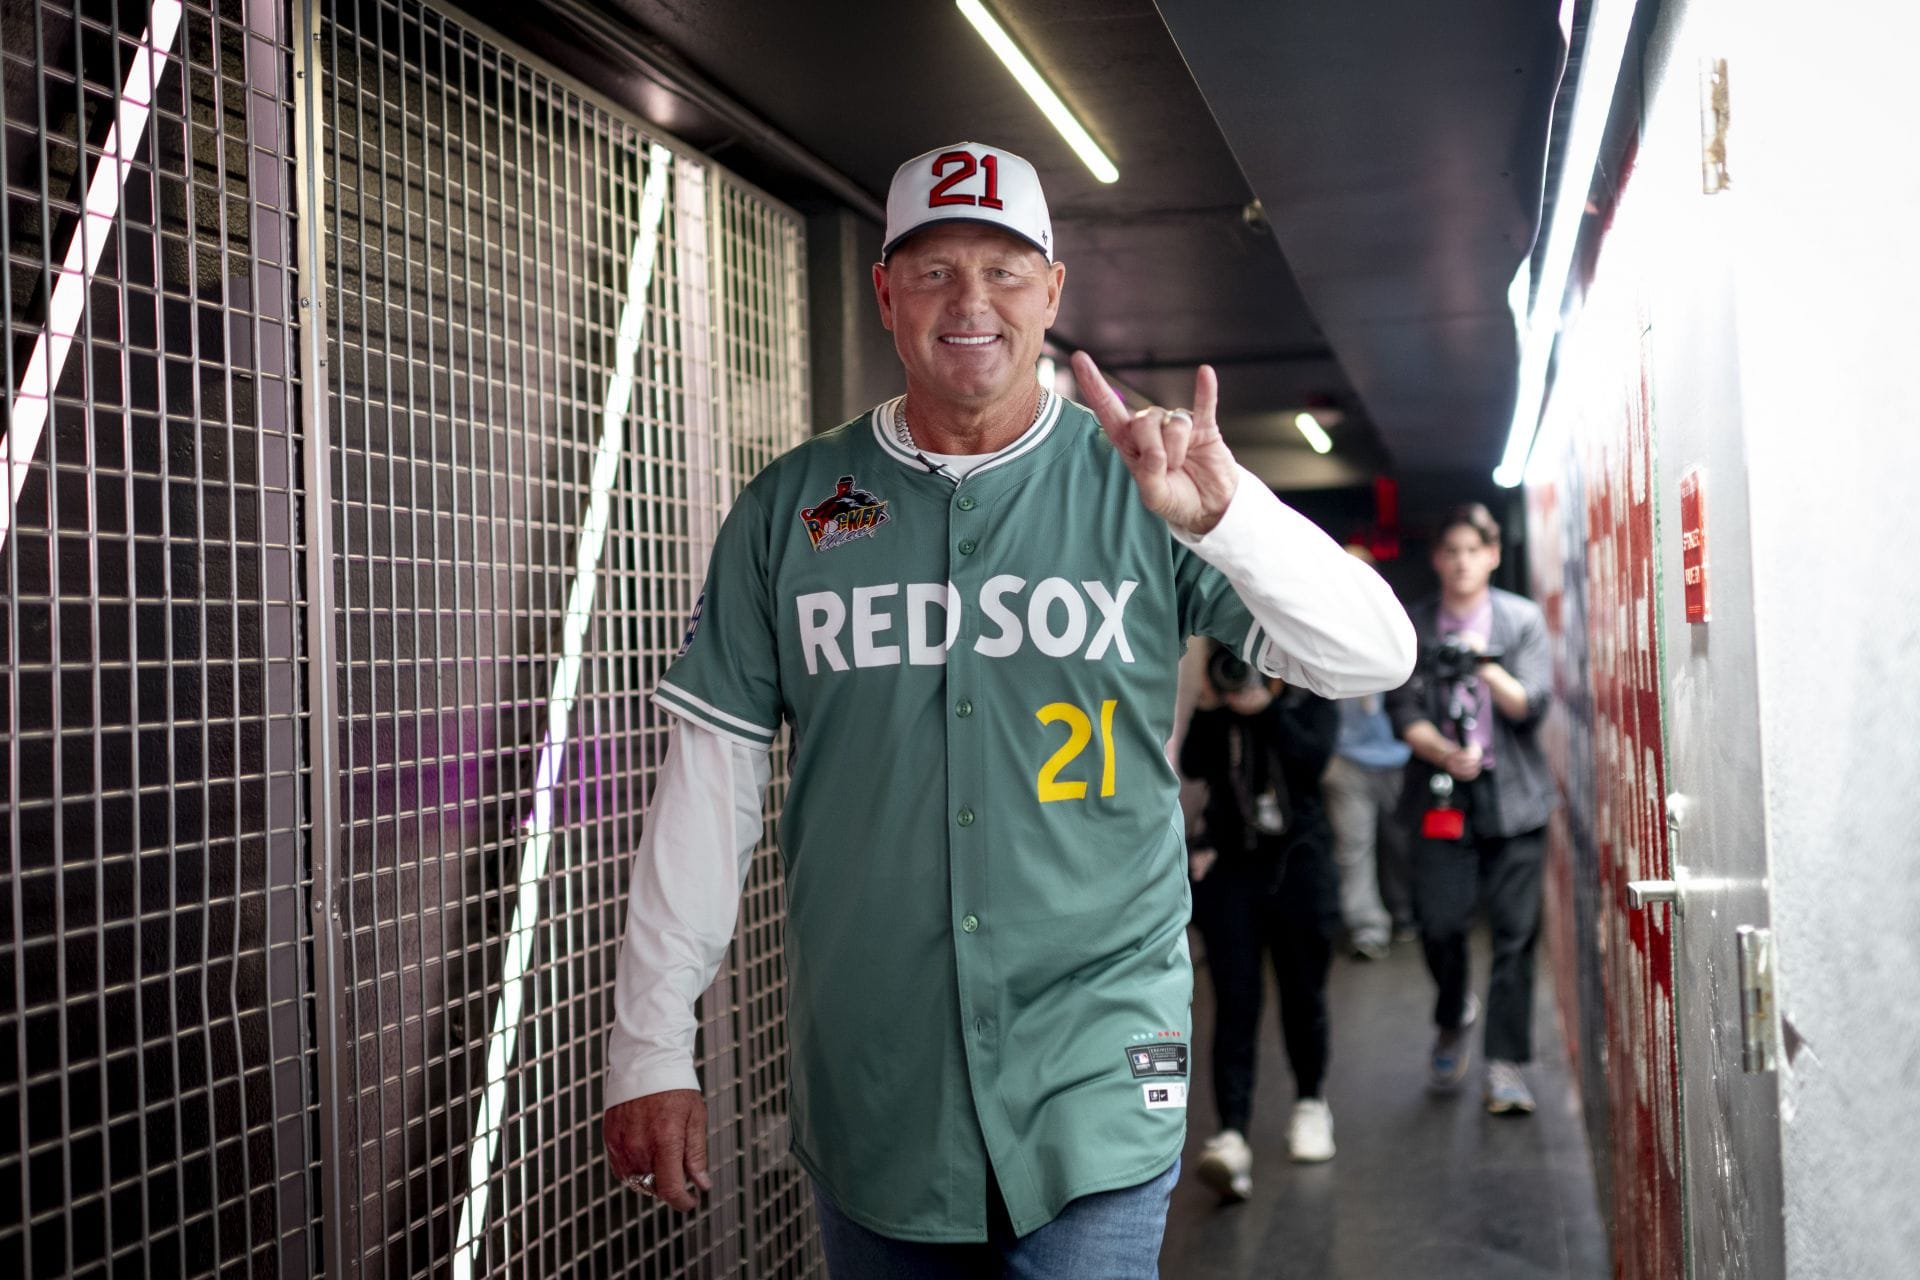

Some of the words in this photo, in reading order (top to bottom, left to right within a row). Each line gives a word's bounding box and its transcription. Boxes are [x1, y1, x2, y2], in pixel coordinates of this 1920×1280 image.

[929, 151, 1003, 210] 21
[796, 580, 962, 675] RED
[973, 574, 1139, 663] SOX
[1035, 700, 1118, 803] 21
